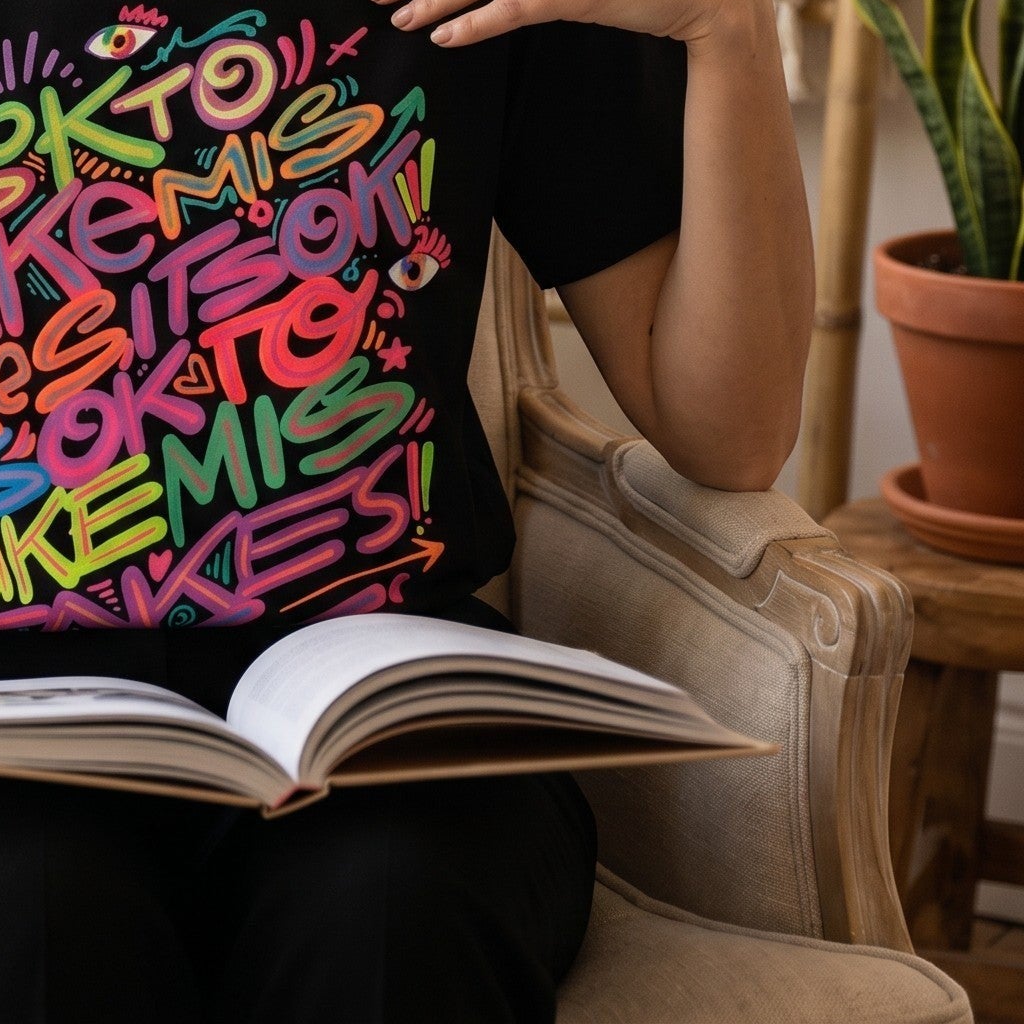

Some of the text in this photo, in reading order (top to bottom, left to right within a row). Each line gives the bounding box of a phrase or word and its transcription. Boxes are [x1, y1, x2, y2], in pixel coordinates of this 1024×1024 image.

[110, 38, 278, 142] TO
[153, 84, 384, 240] MIS
[131, 219, 289, 359] ITS
[37, 339, 206, 489] OK
[199, 269, 378, 404] TO
[162, 355, 415, 548] MIS
